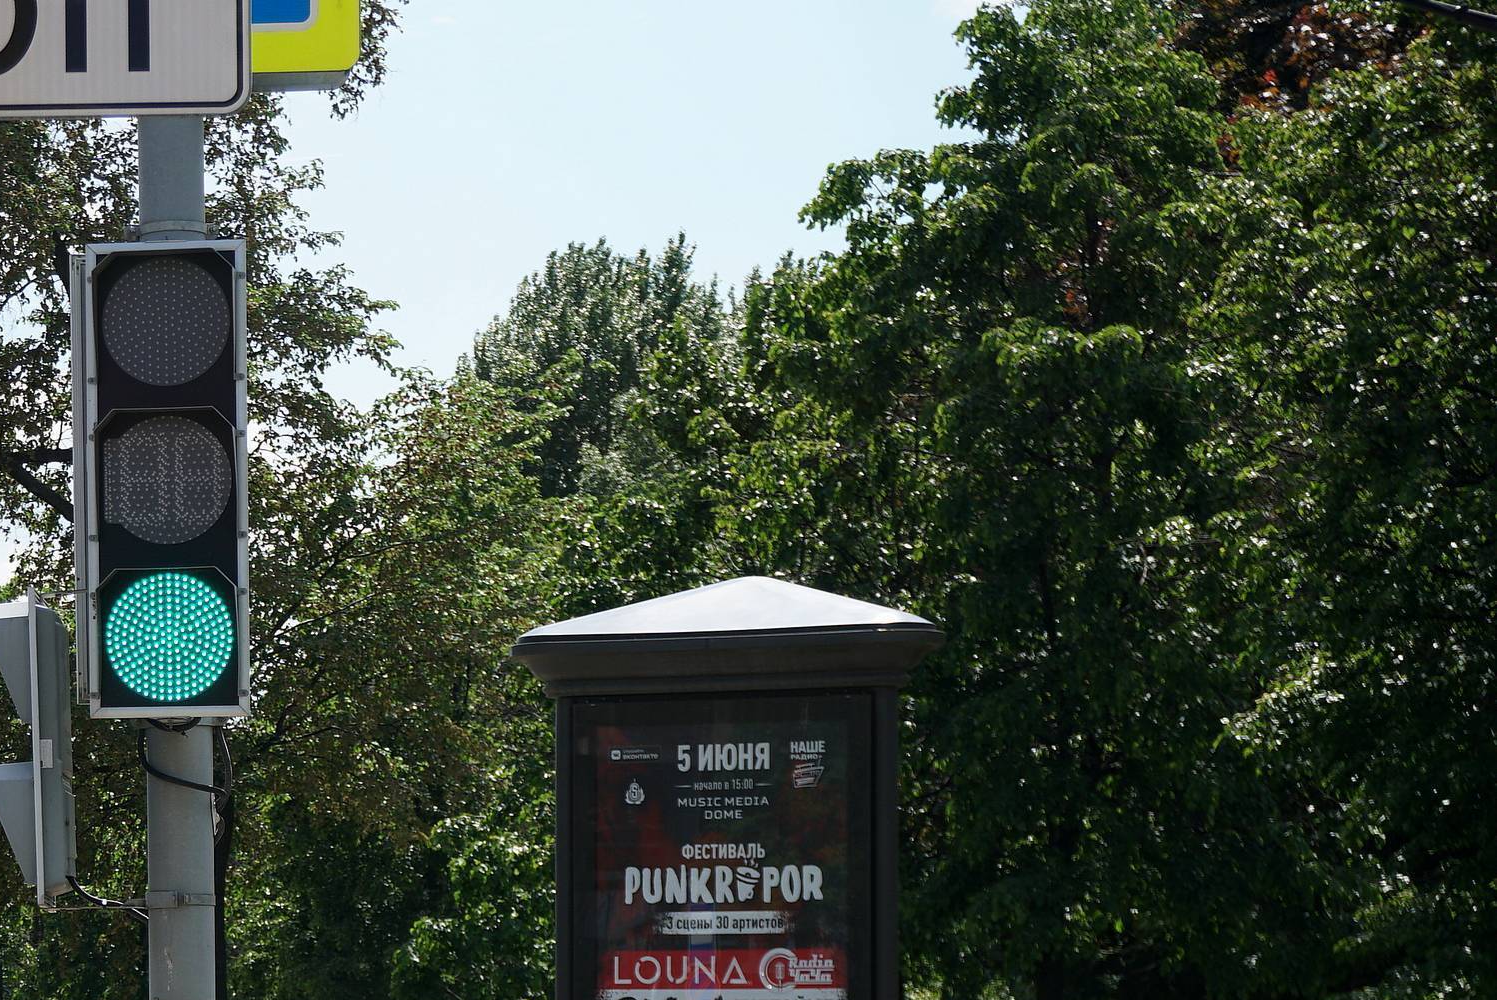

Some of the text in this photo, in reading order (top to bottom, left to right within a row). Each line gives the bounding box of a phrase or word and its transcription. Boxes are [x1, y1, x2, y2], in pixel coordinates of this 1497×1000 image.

[790, 740, 826, 753] НАШЕ
[677, 742, 771, 772] 5 ИЮНЯ
[694, 782, 723, 791] начало
[732, 778, 754, 790] 15:00
[677, 796, 770, 808] MUSIC MEDIA
[704, 810, 744, 820] DOME
[682, 843, 766, 859] ФЕСТИВАЛЬ
[667, 916, 784, 931] 3 сцены 30 артистов
[614, 955, 748, 985] LOUNA
